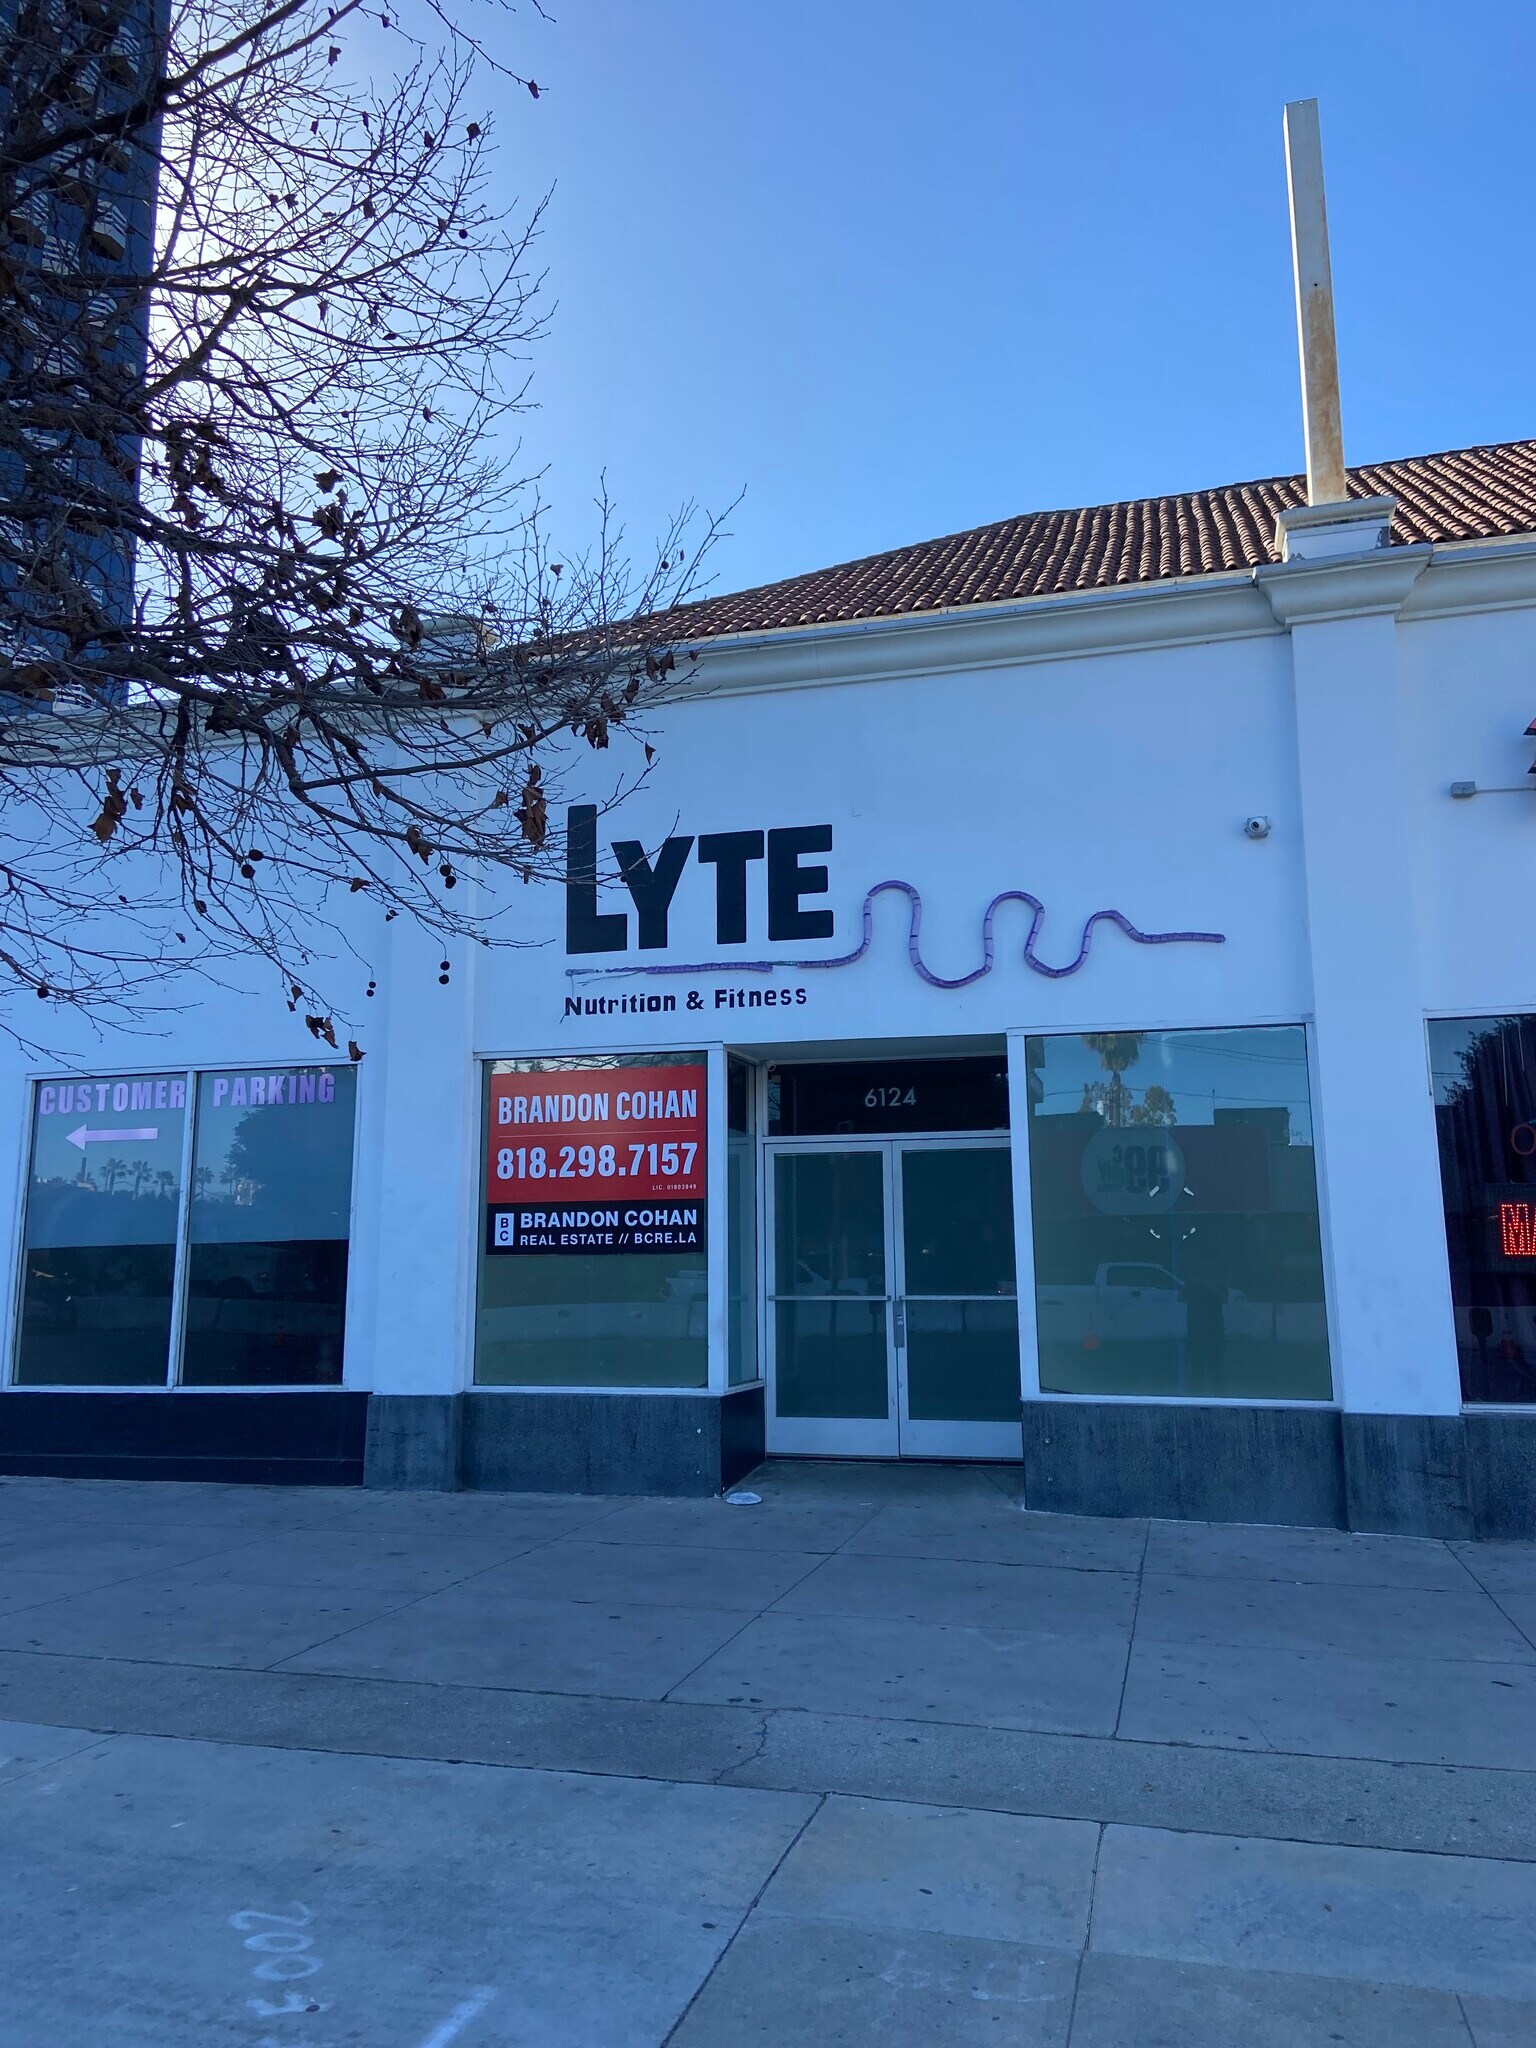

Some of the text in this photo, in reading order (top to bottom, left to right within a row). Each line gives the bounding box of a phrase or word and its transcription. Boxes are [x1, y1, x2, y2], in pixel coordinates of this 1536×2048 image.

[566, 804, 834, 955] LYTE
[564, 987, 808, 1016] Nutrition & Fitness
[39, 1073, 336, 1115] CUSTOMER PARKING
[498, 1089, 697, 1124] BRANDON COHAN
[864, 1086, 917, 1108] 6124
[496, 1142, 698, 1180] 818.298.7157
[500, 1217, 509, 1228] B
[520, 1209, 697, 1228] BRANDON COHAN
[500, 1230, 509, 1242] C
[520, 1235, 556, 1246] REAL
[560, 1233, 614, 1245] ESTATE
[634, 1232, 697, 1244] BCRE.LA
